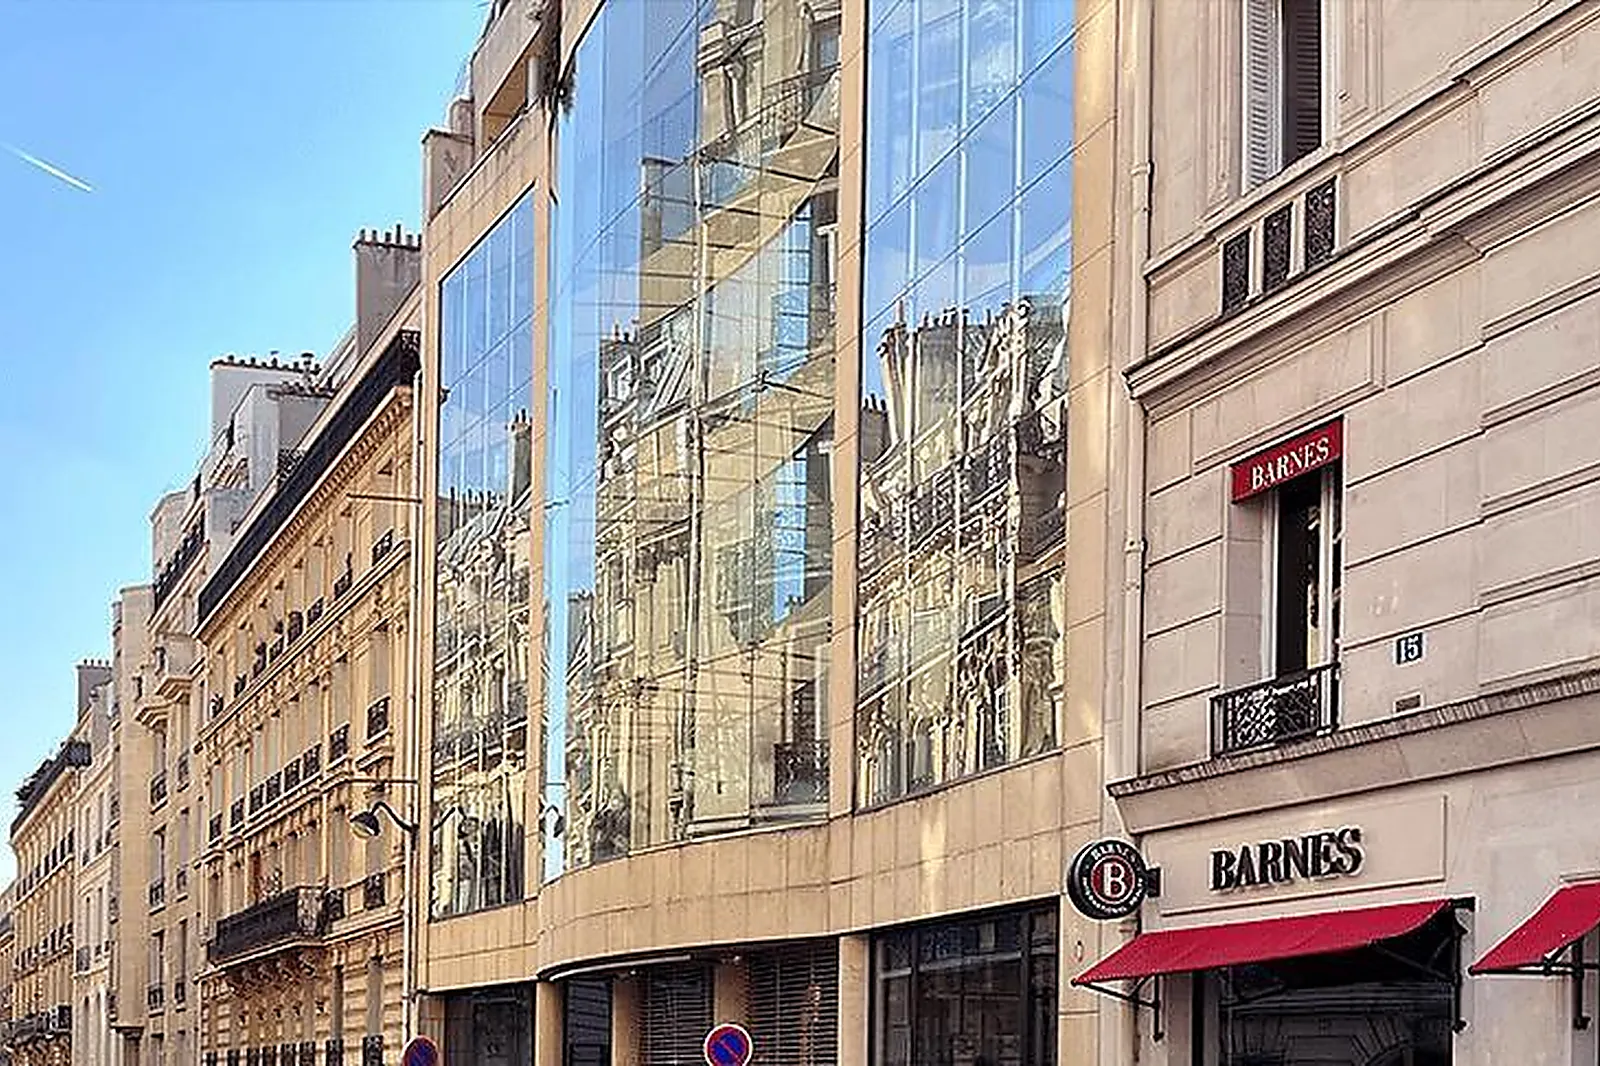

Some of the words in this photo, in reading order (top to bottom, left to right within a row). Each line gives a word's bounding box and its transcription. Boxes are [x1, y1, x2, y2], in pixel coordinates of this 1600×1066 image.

[1252, 437, 1329, 490] BARNES
[1400, 635, 1419, 661] 15
[1103, 862, 1127, 898] B
[1210, 828, 1362, 891] BARNES
